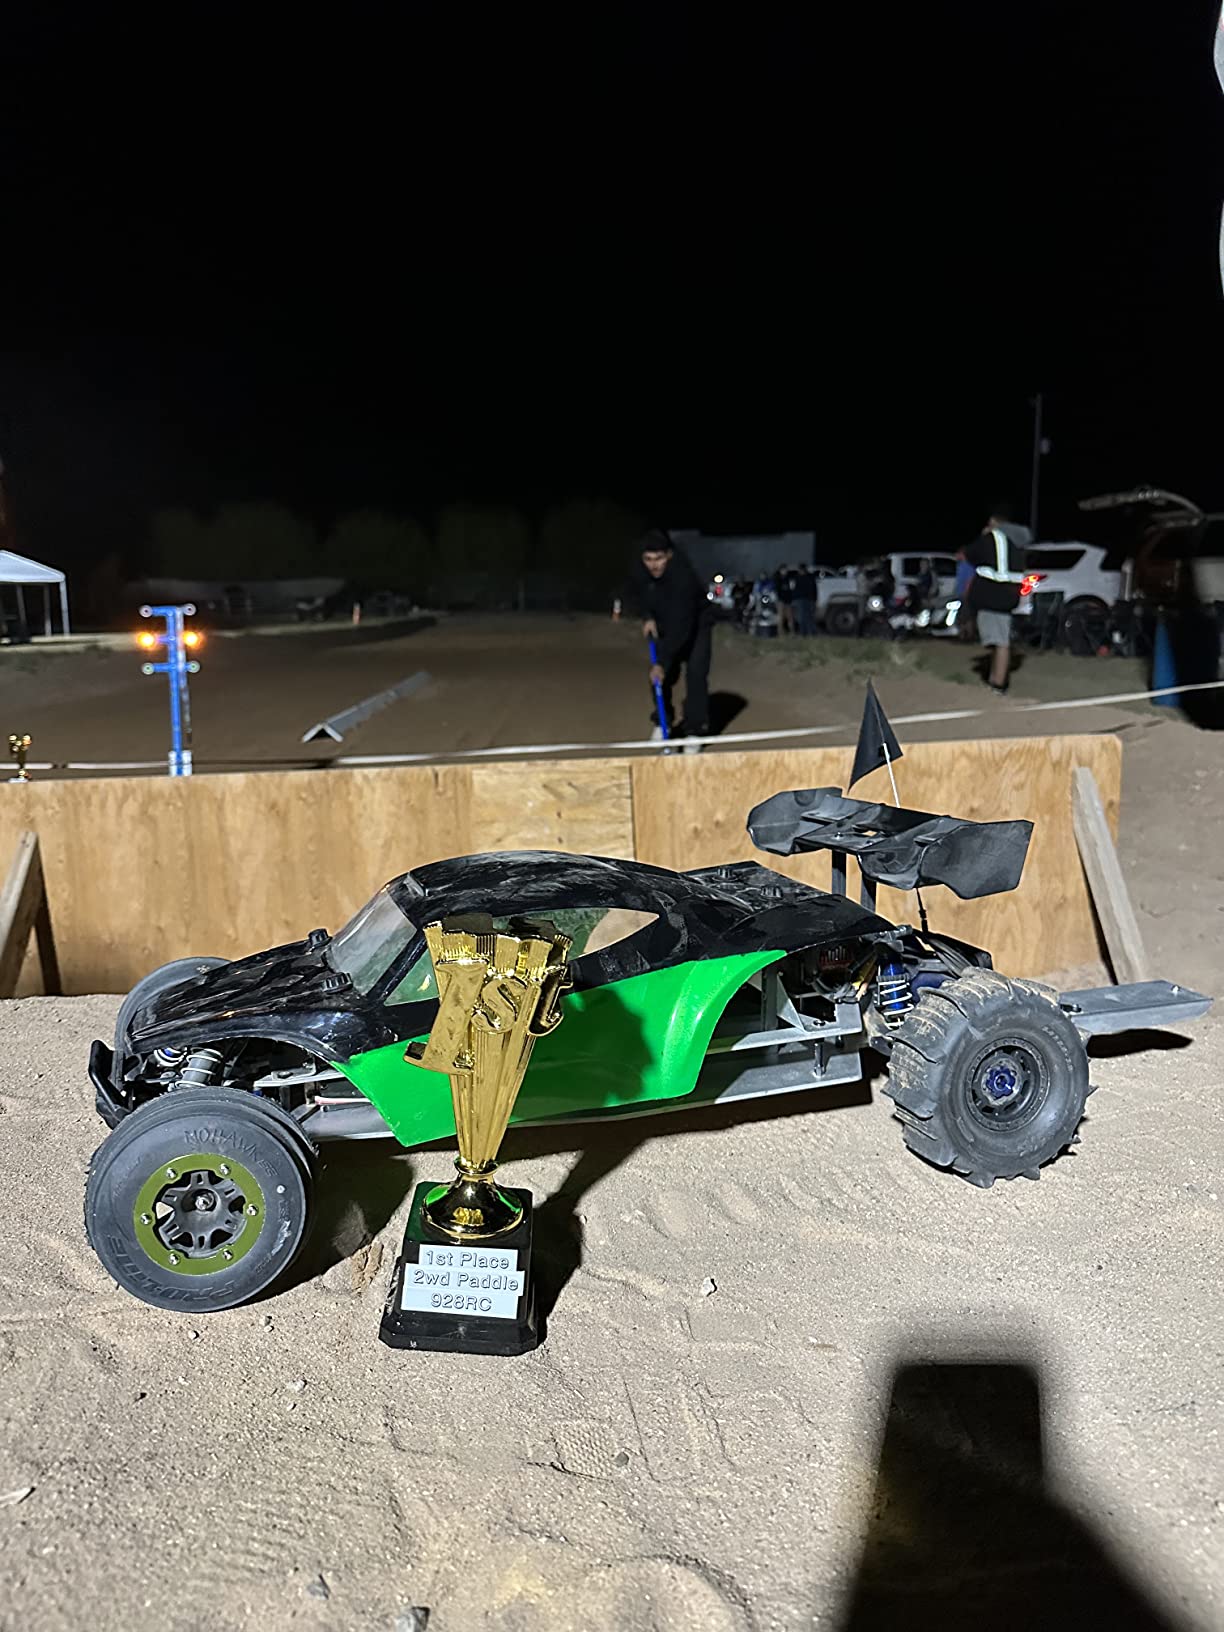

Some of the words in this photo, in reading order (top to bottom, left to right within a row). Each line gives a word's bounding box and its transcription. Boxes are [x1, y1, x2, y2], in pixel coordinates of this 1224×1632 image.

[425, 1250, 454, 1266] 1st
[460, 1251, 510, 1270] Place
[413, 1269, 451, 1287] 2wd
[457, 1271, 519, 1291] Paddle
[430, 1293, 493, 1312] 928RC
